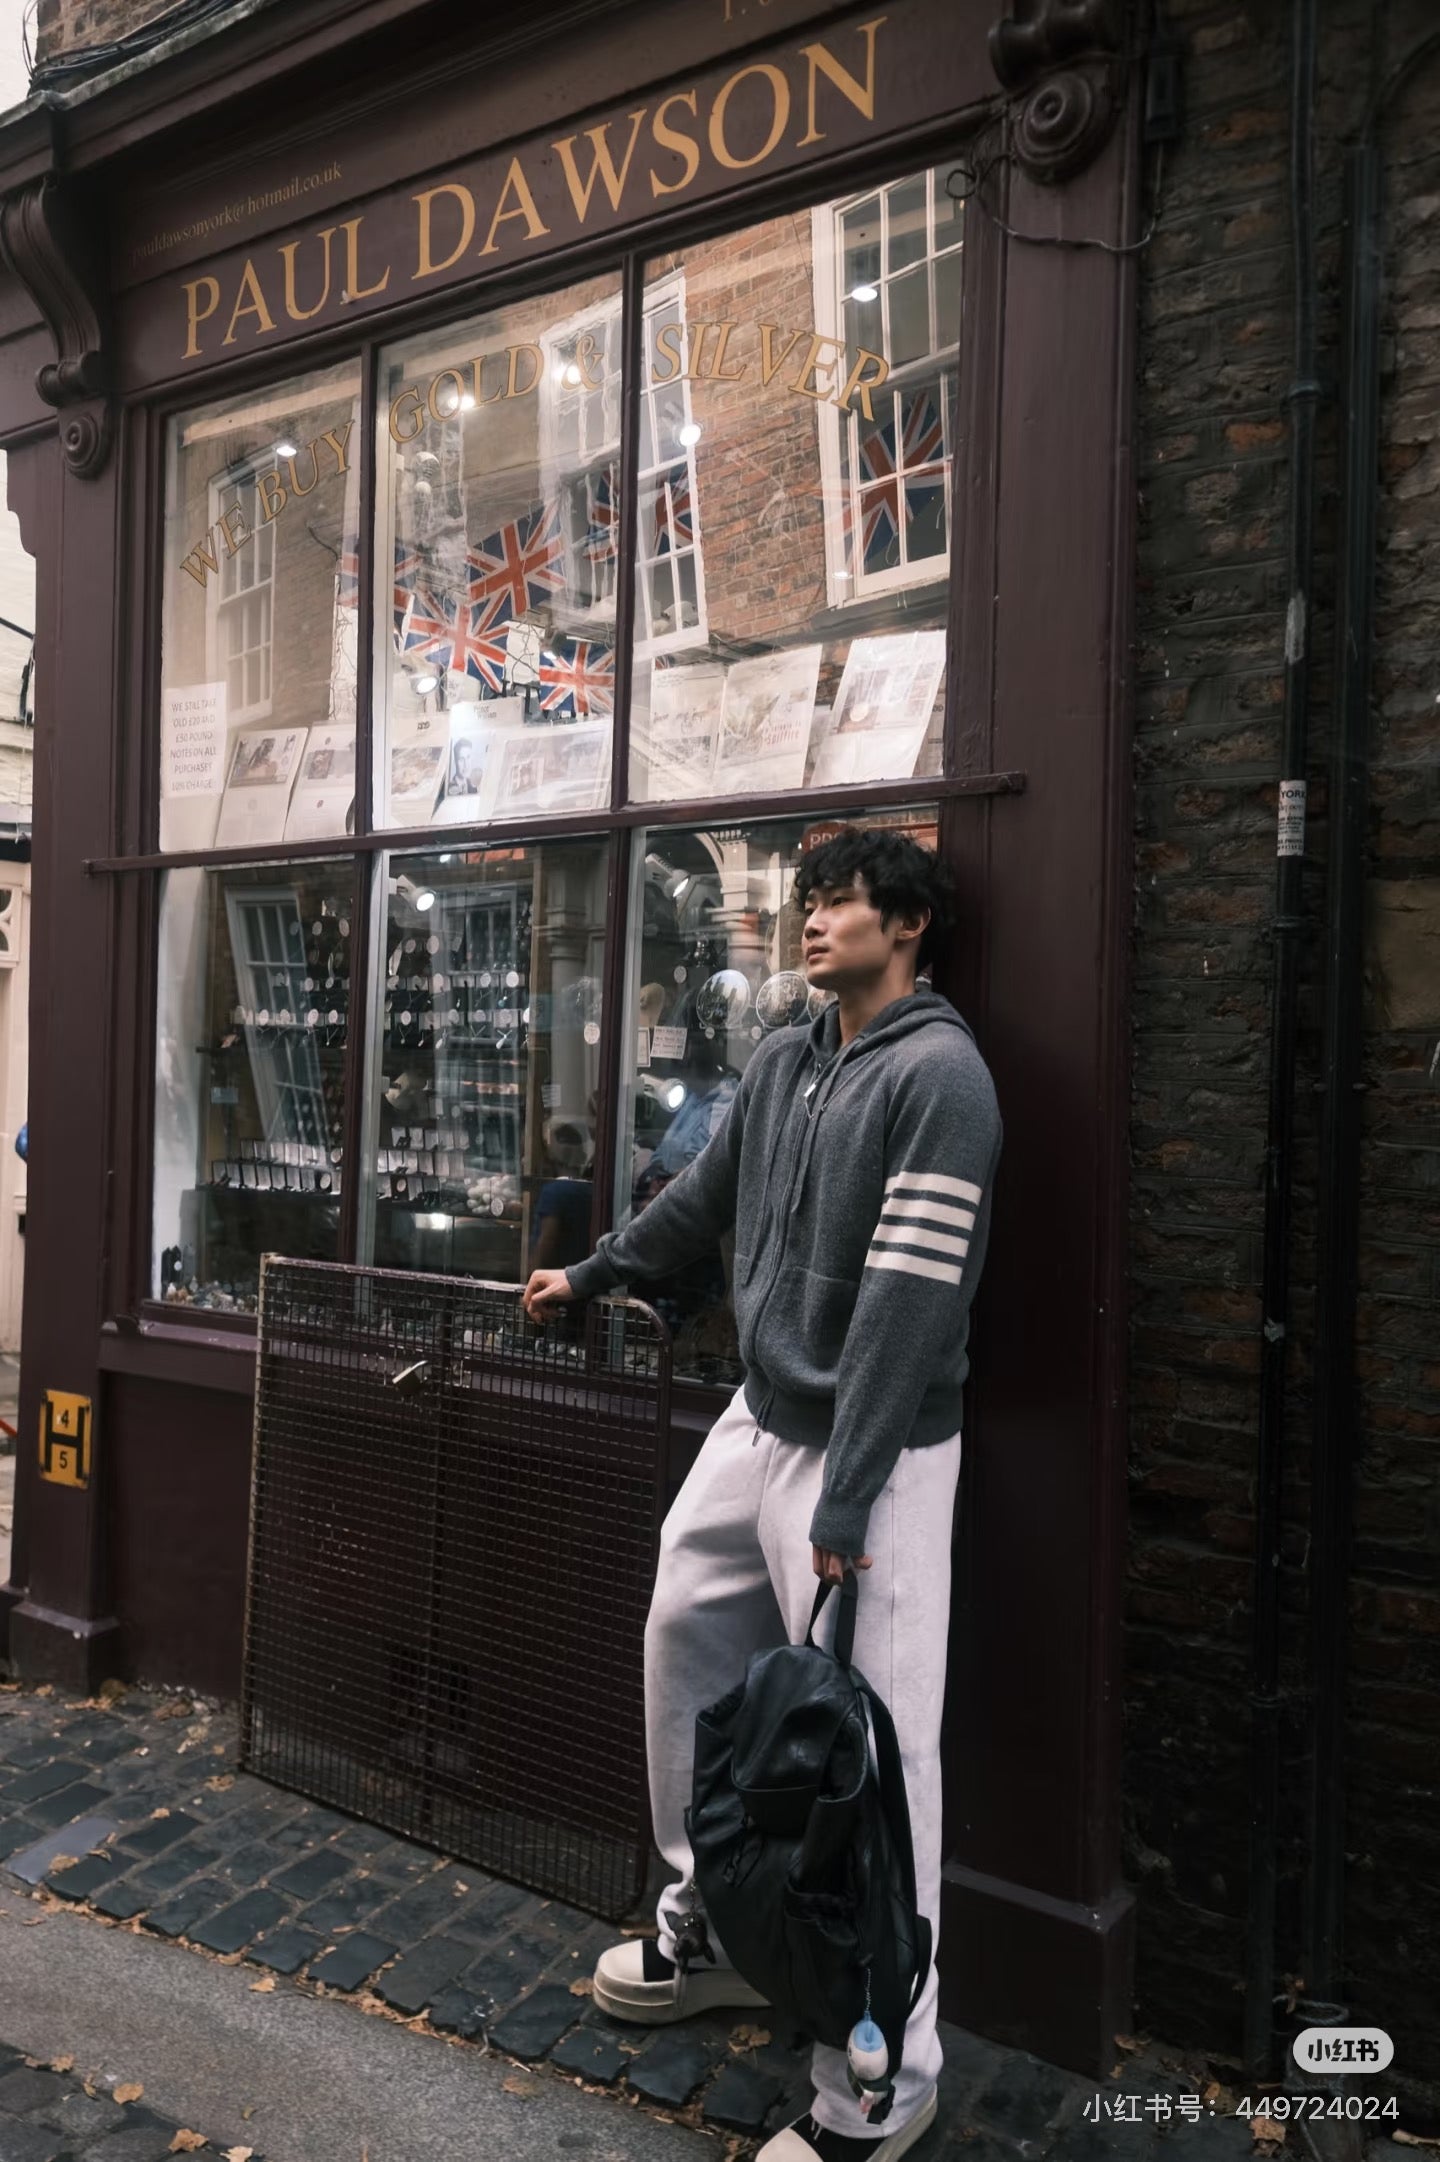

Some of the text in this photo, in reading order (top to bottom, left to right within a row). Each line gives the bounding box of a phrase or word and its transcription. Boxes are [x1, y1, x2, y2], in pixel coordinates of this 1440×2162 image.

[180, 16, 888, 360] PAUL DAWSON
[179, 320, 890, 589] WE BUY GOLD & SILVER
[59, 1450, 68, 1469] 5
[61, 1409, 69, 1428] 4
